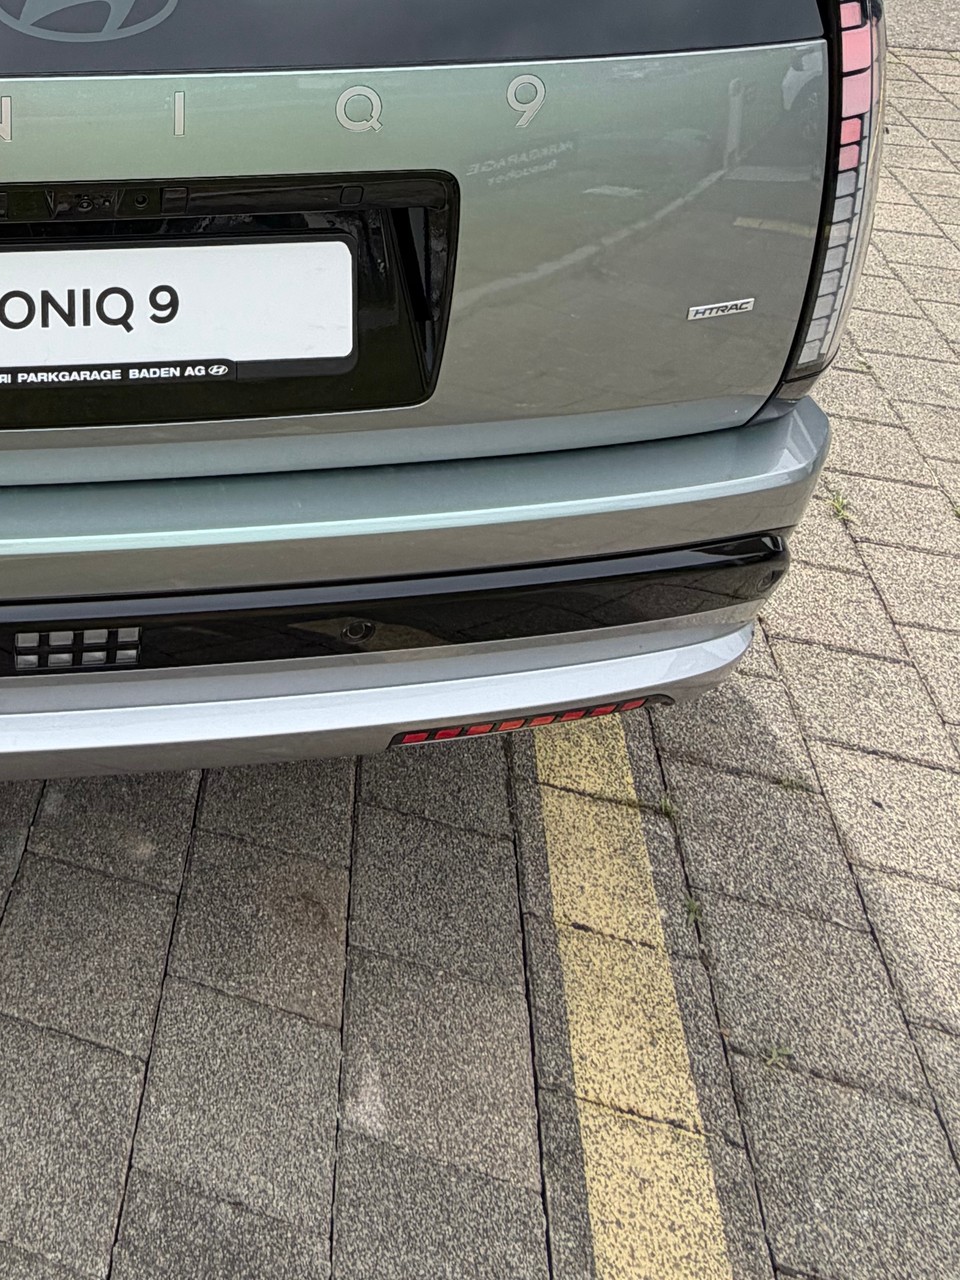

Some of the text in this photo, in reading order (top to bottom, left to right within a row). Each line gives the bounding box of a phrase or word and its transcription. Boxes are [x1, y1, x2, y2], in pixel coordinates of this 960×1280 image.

[506, 73, 546, 128] 9
[148, 284, 180, 325] 9
[692, 300, 752, 318] HTRAC
[17, 369, 122, 383] PARKGARAGE
[128, 367, 181, 379] BADEN
[184, 365, 206, 377] AG
